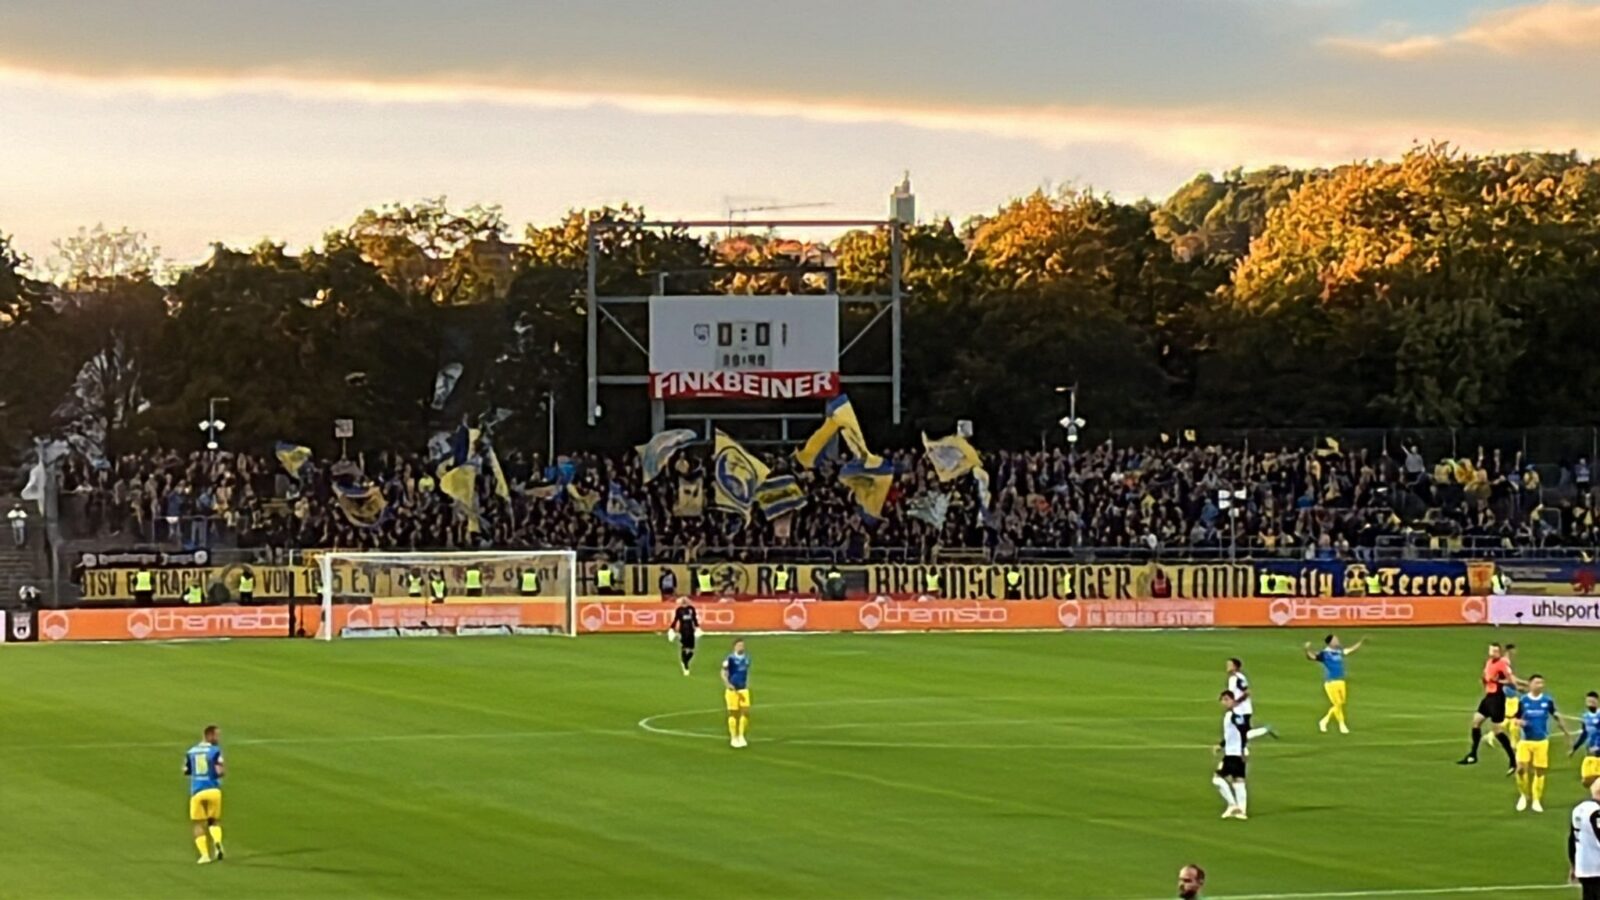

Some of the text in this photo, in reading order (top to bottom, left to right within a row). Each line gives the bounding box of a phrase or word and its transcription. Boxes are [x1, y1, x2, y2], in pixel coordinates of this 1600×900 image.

[654, 371, 832, 399] FINKBEINER
[1378, 566, 1466, 596] Terror
[1532, 600, 1600, 622] uhlsport
